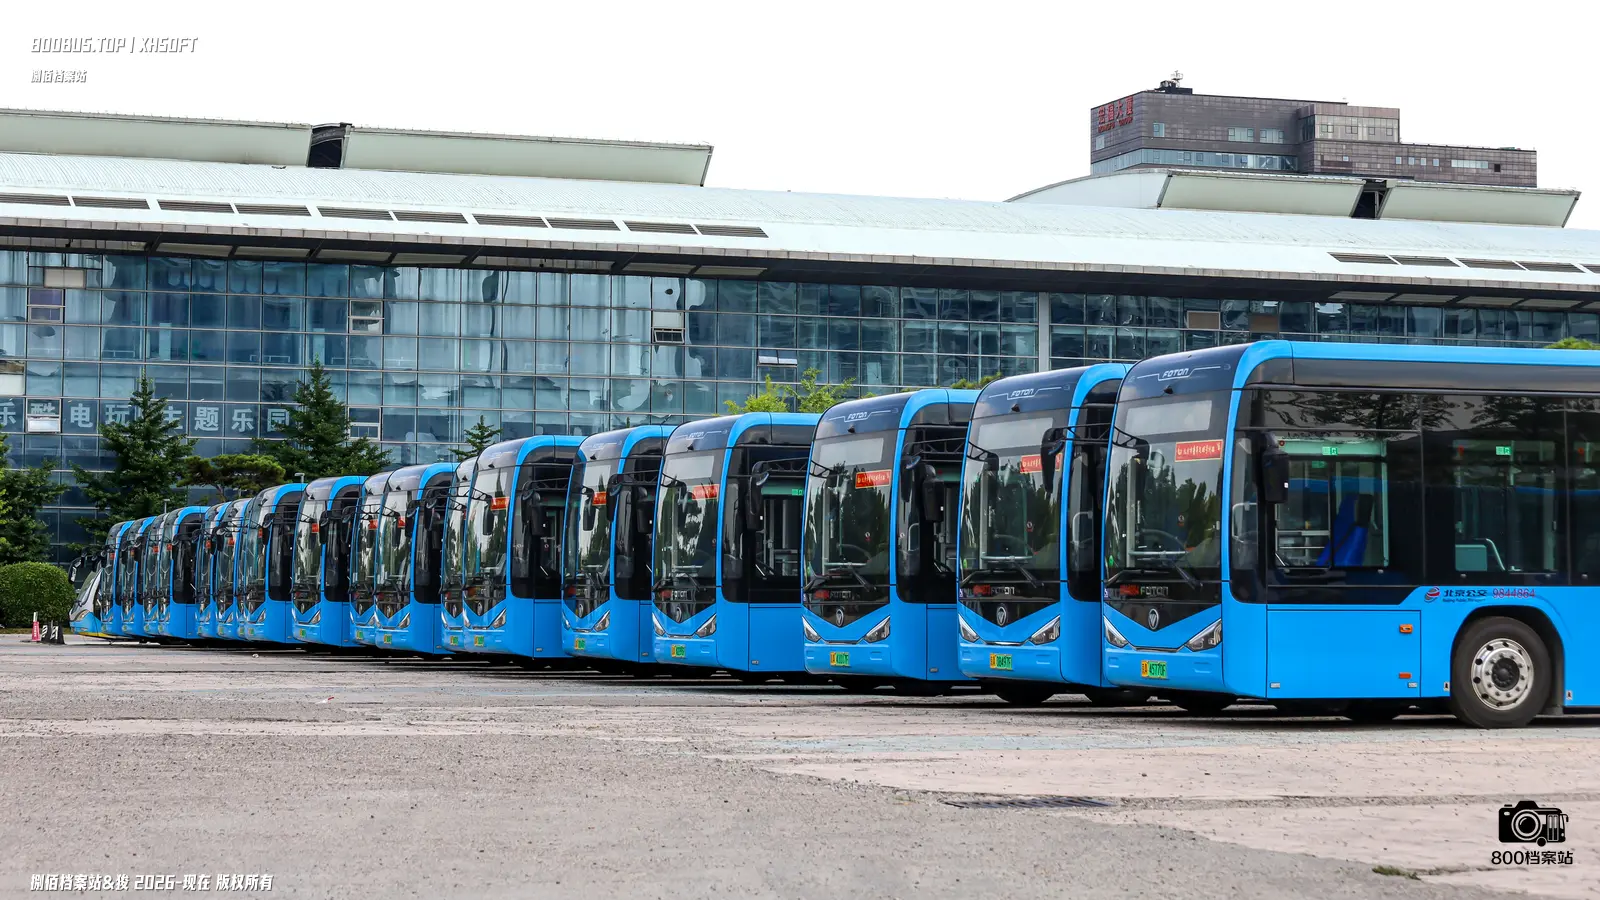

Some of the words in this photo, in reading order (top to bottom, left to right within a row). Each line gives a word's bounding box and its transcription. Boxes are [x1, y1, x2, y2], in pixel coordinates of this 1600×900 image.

[1162, 368, 1189, 378] FOTON
[1010, 388, 1035, 397] FOTON
[1140, 586, 1169, 596] FOTON
[1443, 589, 1488, 597] 北京公交
[1492, 588, 1536, 599] 9844864
